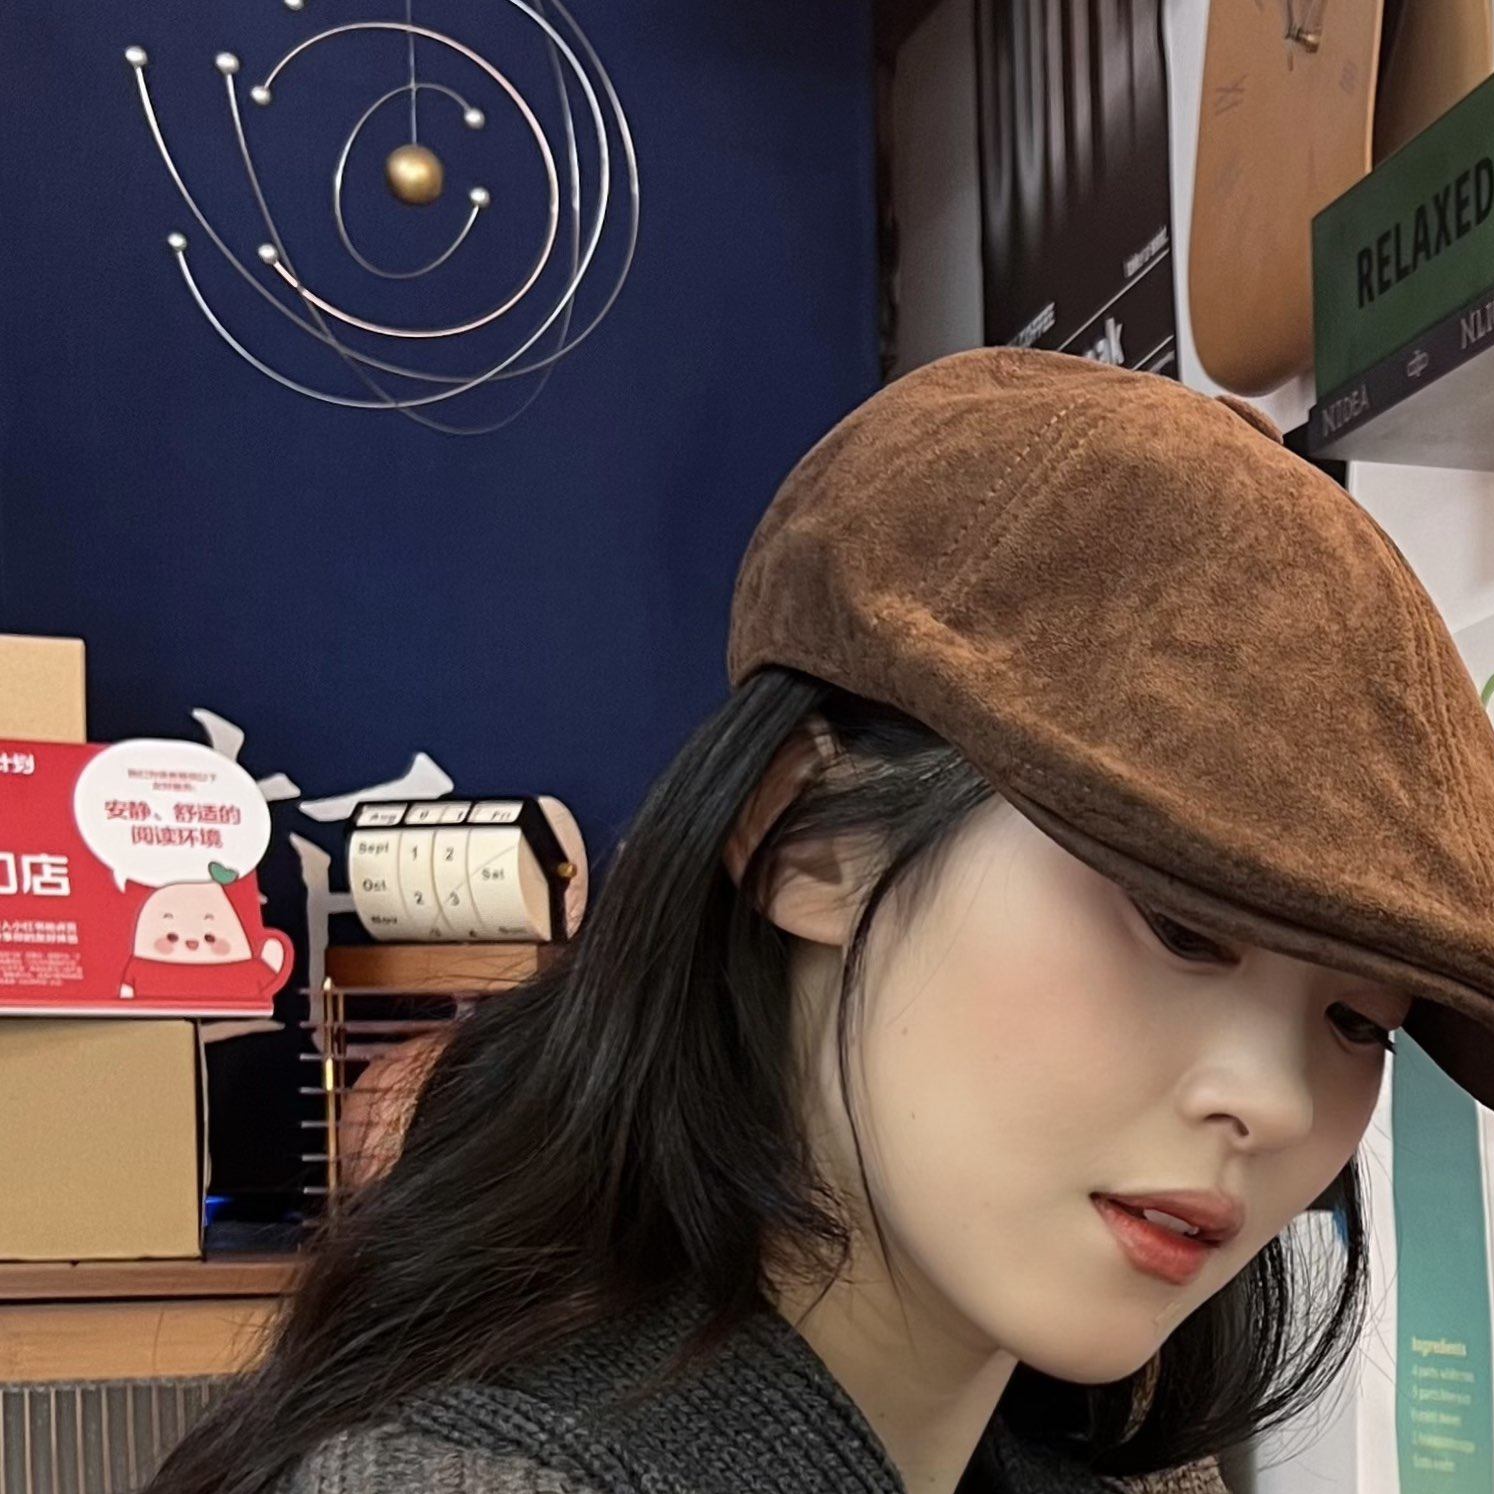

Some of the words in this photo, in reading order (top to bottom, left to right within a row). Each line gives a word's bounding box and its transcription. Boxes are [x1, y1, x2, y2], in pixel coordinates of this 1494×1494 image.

[1357, 157, 1494, 310] RELAXED
[104, 800, 241, 825] 安静、舒适的
[131, 826, 223, 848] 阅读环境
[444, 848, 454, 862] 2
